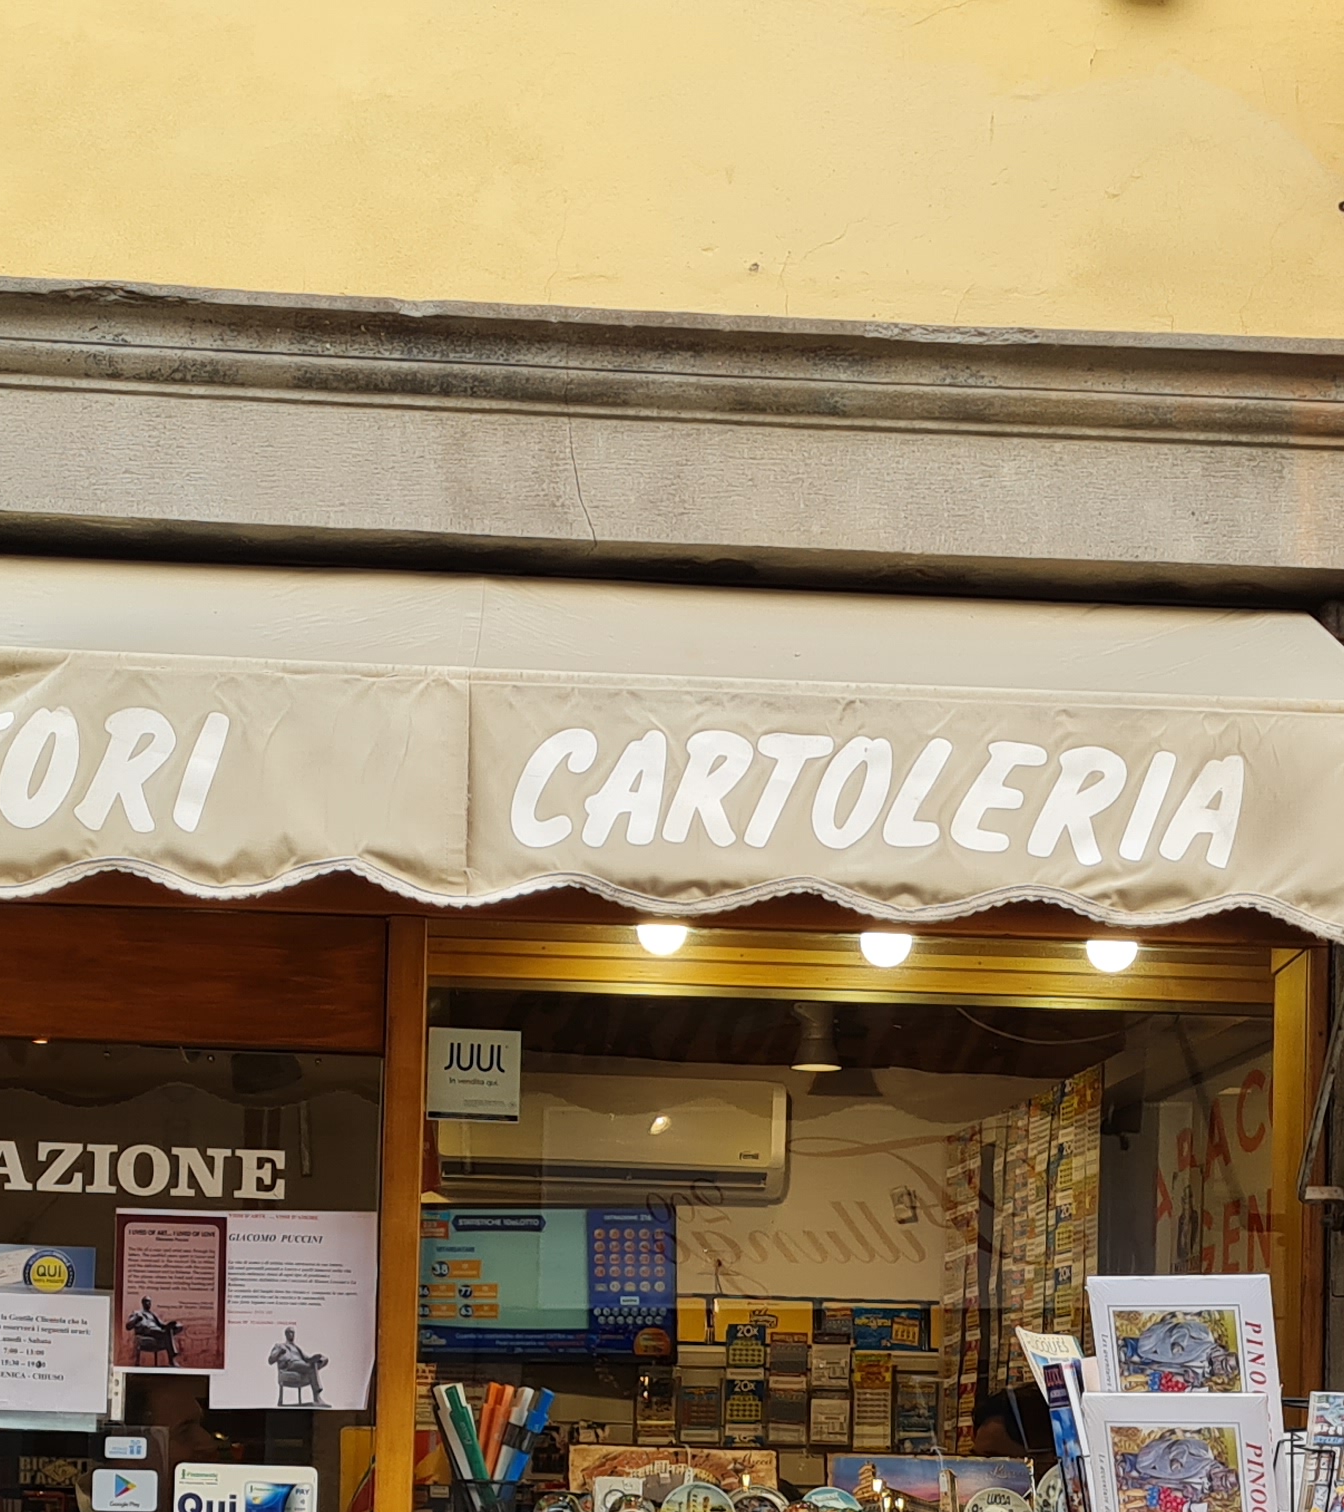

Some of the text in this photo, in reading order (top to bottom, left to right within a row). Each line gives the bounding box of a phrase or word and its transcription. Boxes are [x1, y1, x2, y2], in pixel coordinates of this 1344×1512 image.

[508, 726, 1246, 869] CARTOLERIA
[444, 1042, 506, 1073] JUUL
[228, 1233, 325, 1245] GIACOMO PUCCINI
